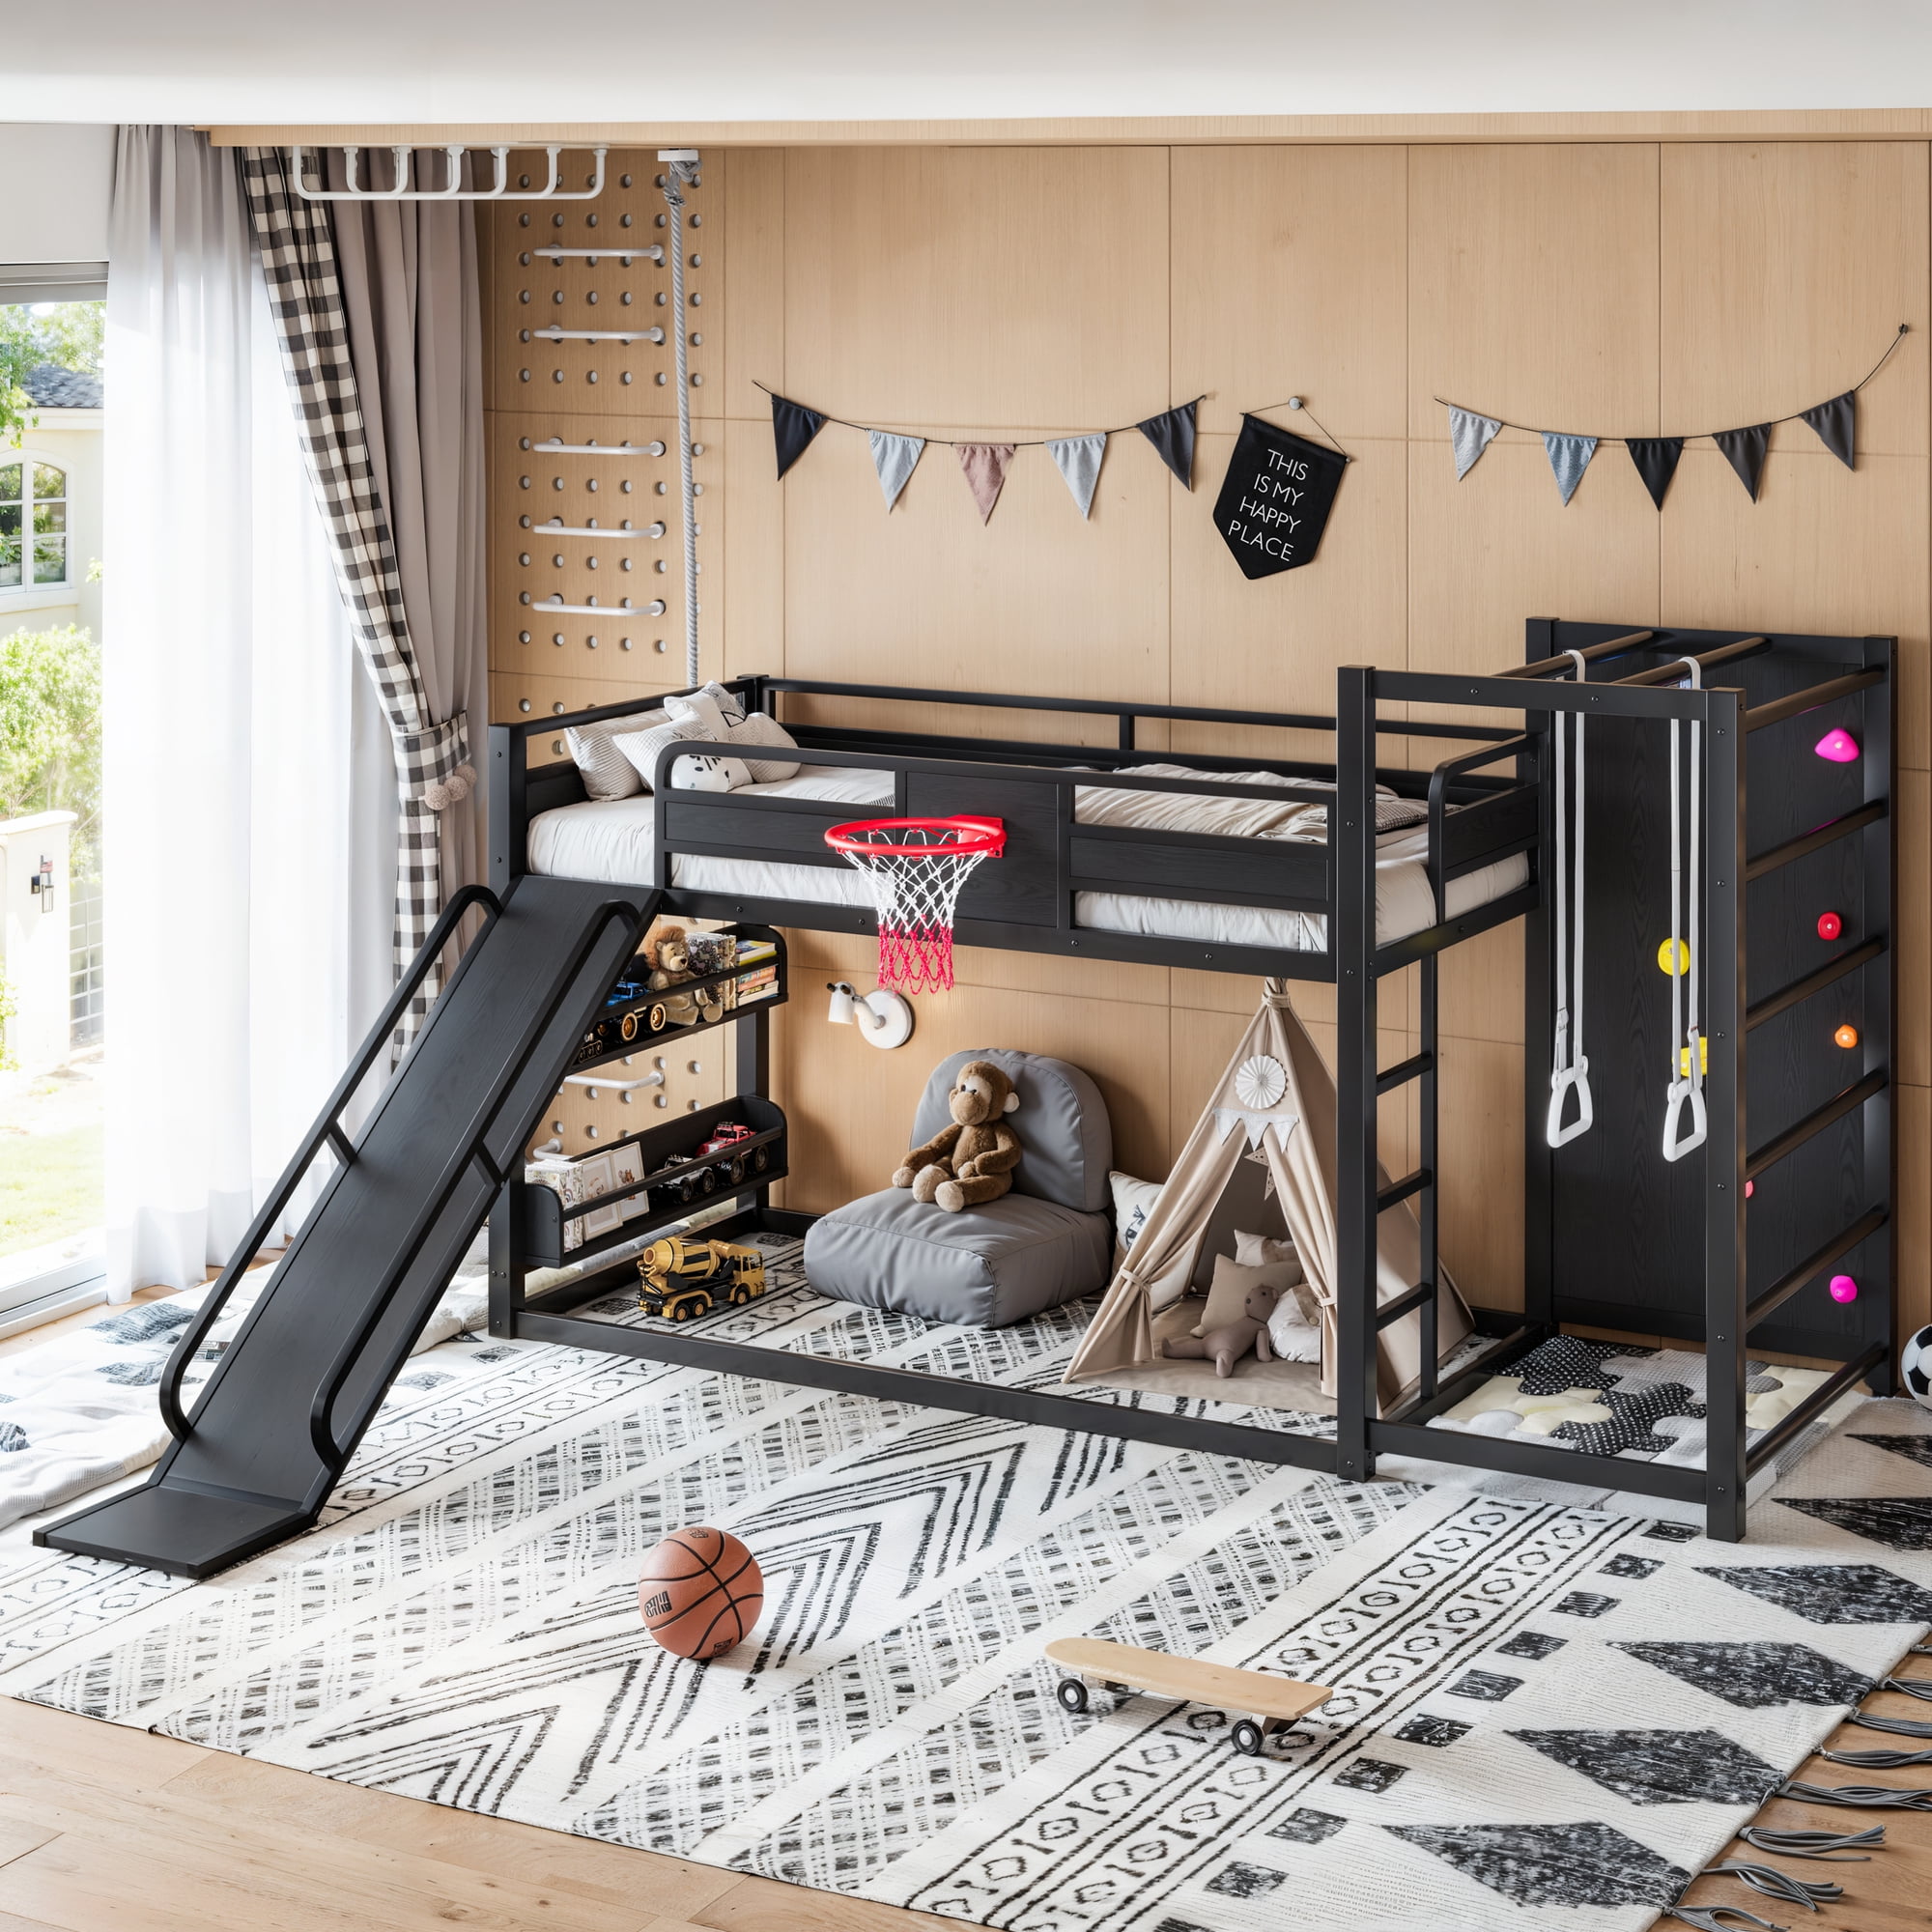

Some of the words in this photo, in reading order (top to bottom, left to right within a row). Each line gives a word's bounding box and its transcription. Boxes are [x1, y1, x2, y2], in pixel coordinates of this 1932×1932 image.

[1267, 448, 1309, 481] THIS
[1253, 473, 1271, 494] IS
[1272, 481, 1304, 506] MY
[1238, 496, 1301, 534] HAPPY
[1228, 520, 1294, 562] PLACE
